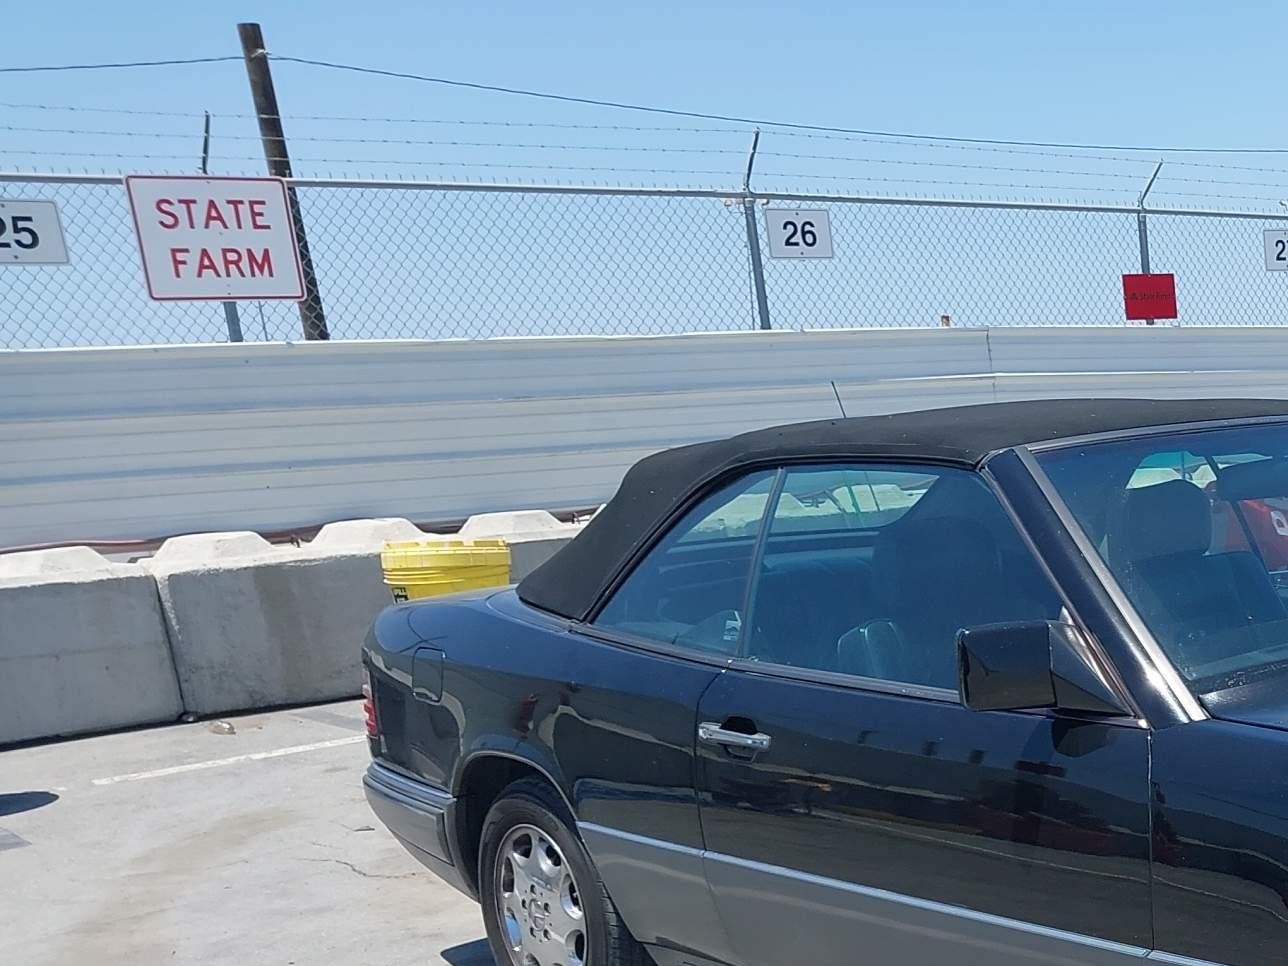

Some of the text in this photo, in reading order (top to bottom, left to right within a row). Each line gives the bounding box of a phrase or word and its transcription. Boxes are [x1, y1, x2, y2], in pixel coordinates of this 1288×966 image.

[155, 199, 271, 229] STATE
[782, 221, 817, 247] 26
[170, 248, 274, 278] FARM
